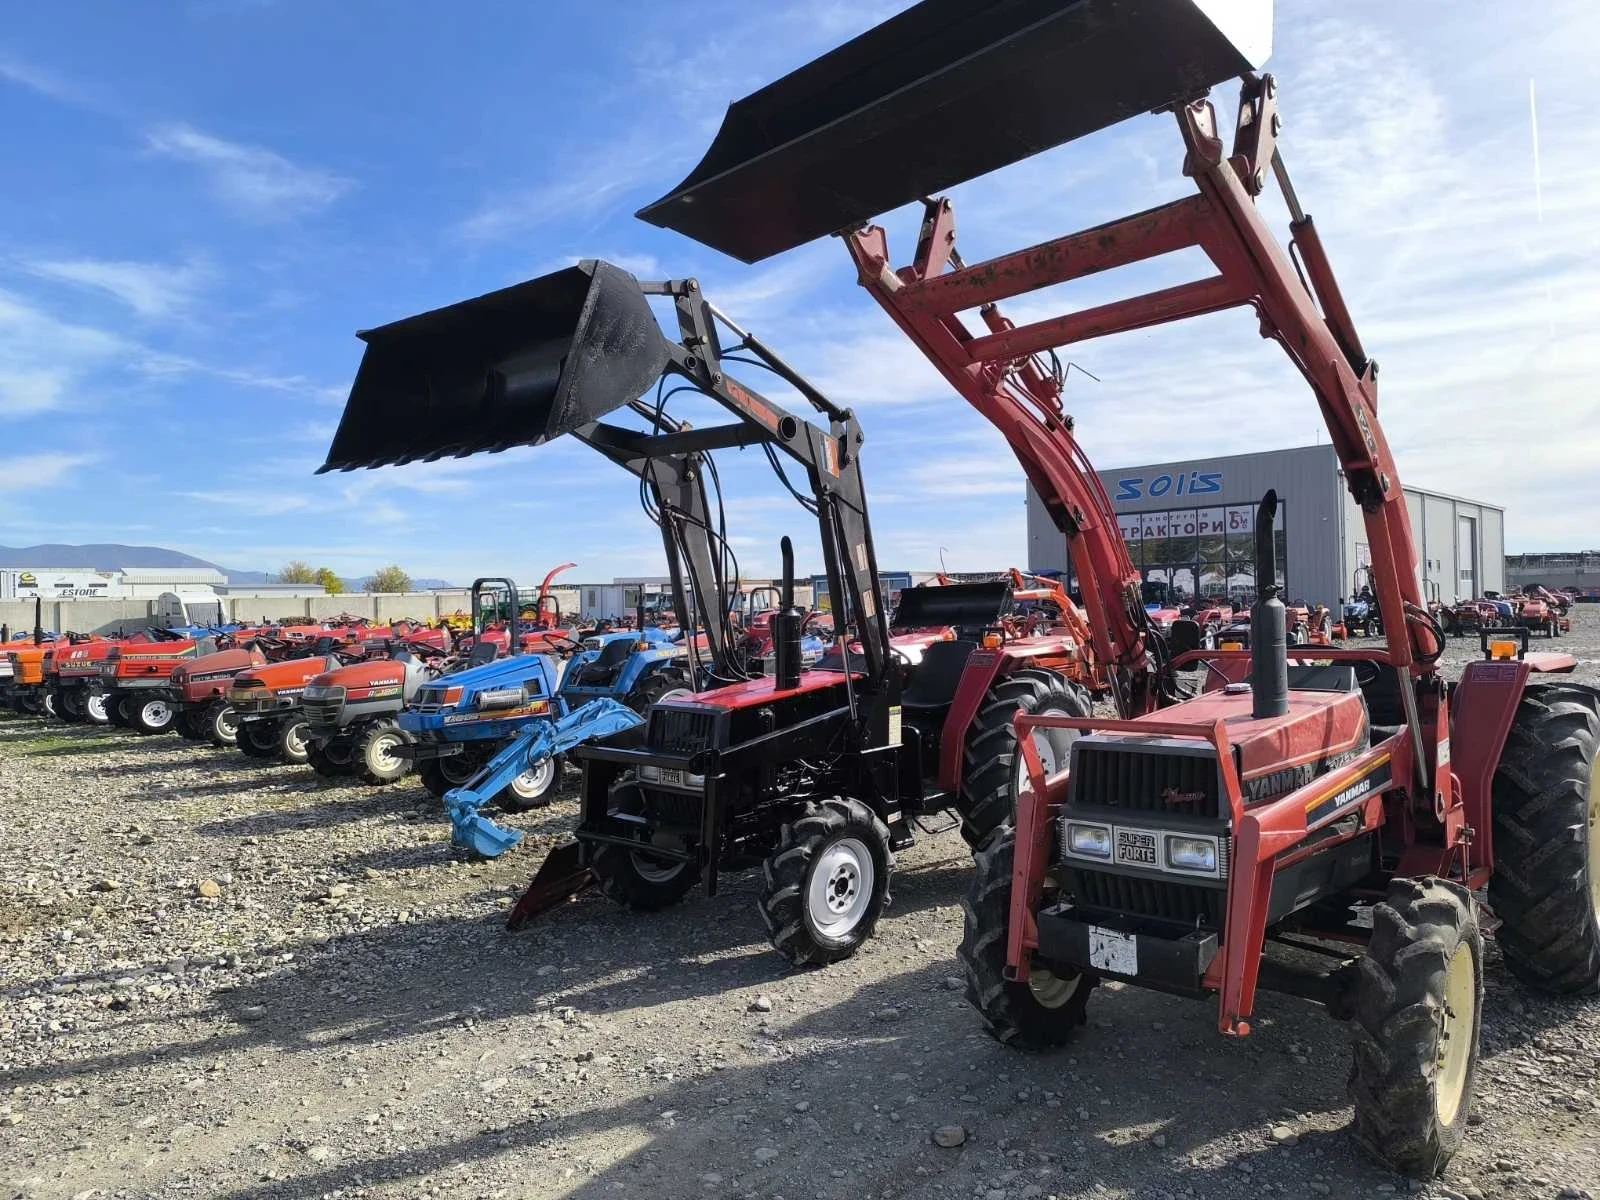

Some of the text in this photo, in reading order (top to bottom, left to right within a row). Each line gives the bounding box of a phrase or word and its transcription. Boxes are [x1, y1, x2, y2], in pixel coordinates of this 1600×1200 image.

[1248, 763, 1314, 800] YANMAR
[1334, 779, 1371, 808] YANMAR
[1118, 831, 1155, 847] SUPER
[1118, 844, 1156, 864] FORTE
